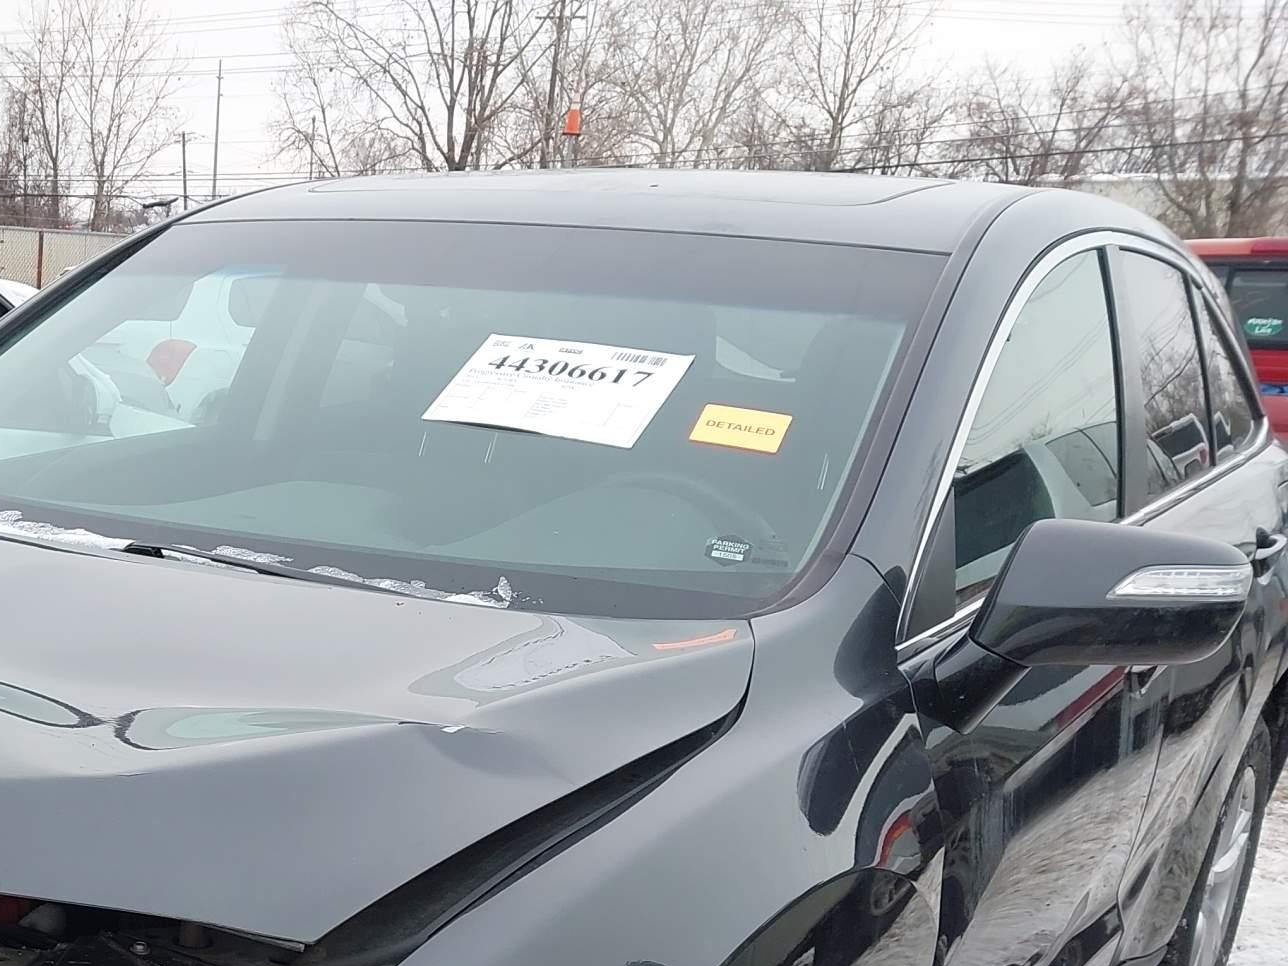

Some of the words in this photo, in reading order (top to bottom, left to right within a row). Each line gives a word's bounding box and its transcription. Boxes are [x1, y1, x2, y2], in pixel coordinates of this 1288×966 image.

[488, 354, 655, 387] 44306617
[705, 420, 776, 436] DETAILED
[712, 539, 750, 550] PARKING
[713, 544, 745, 554] PERMIT
